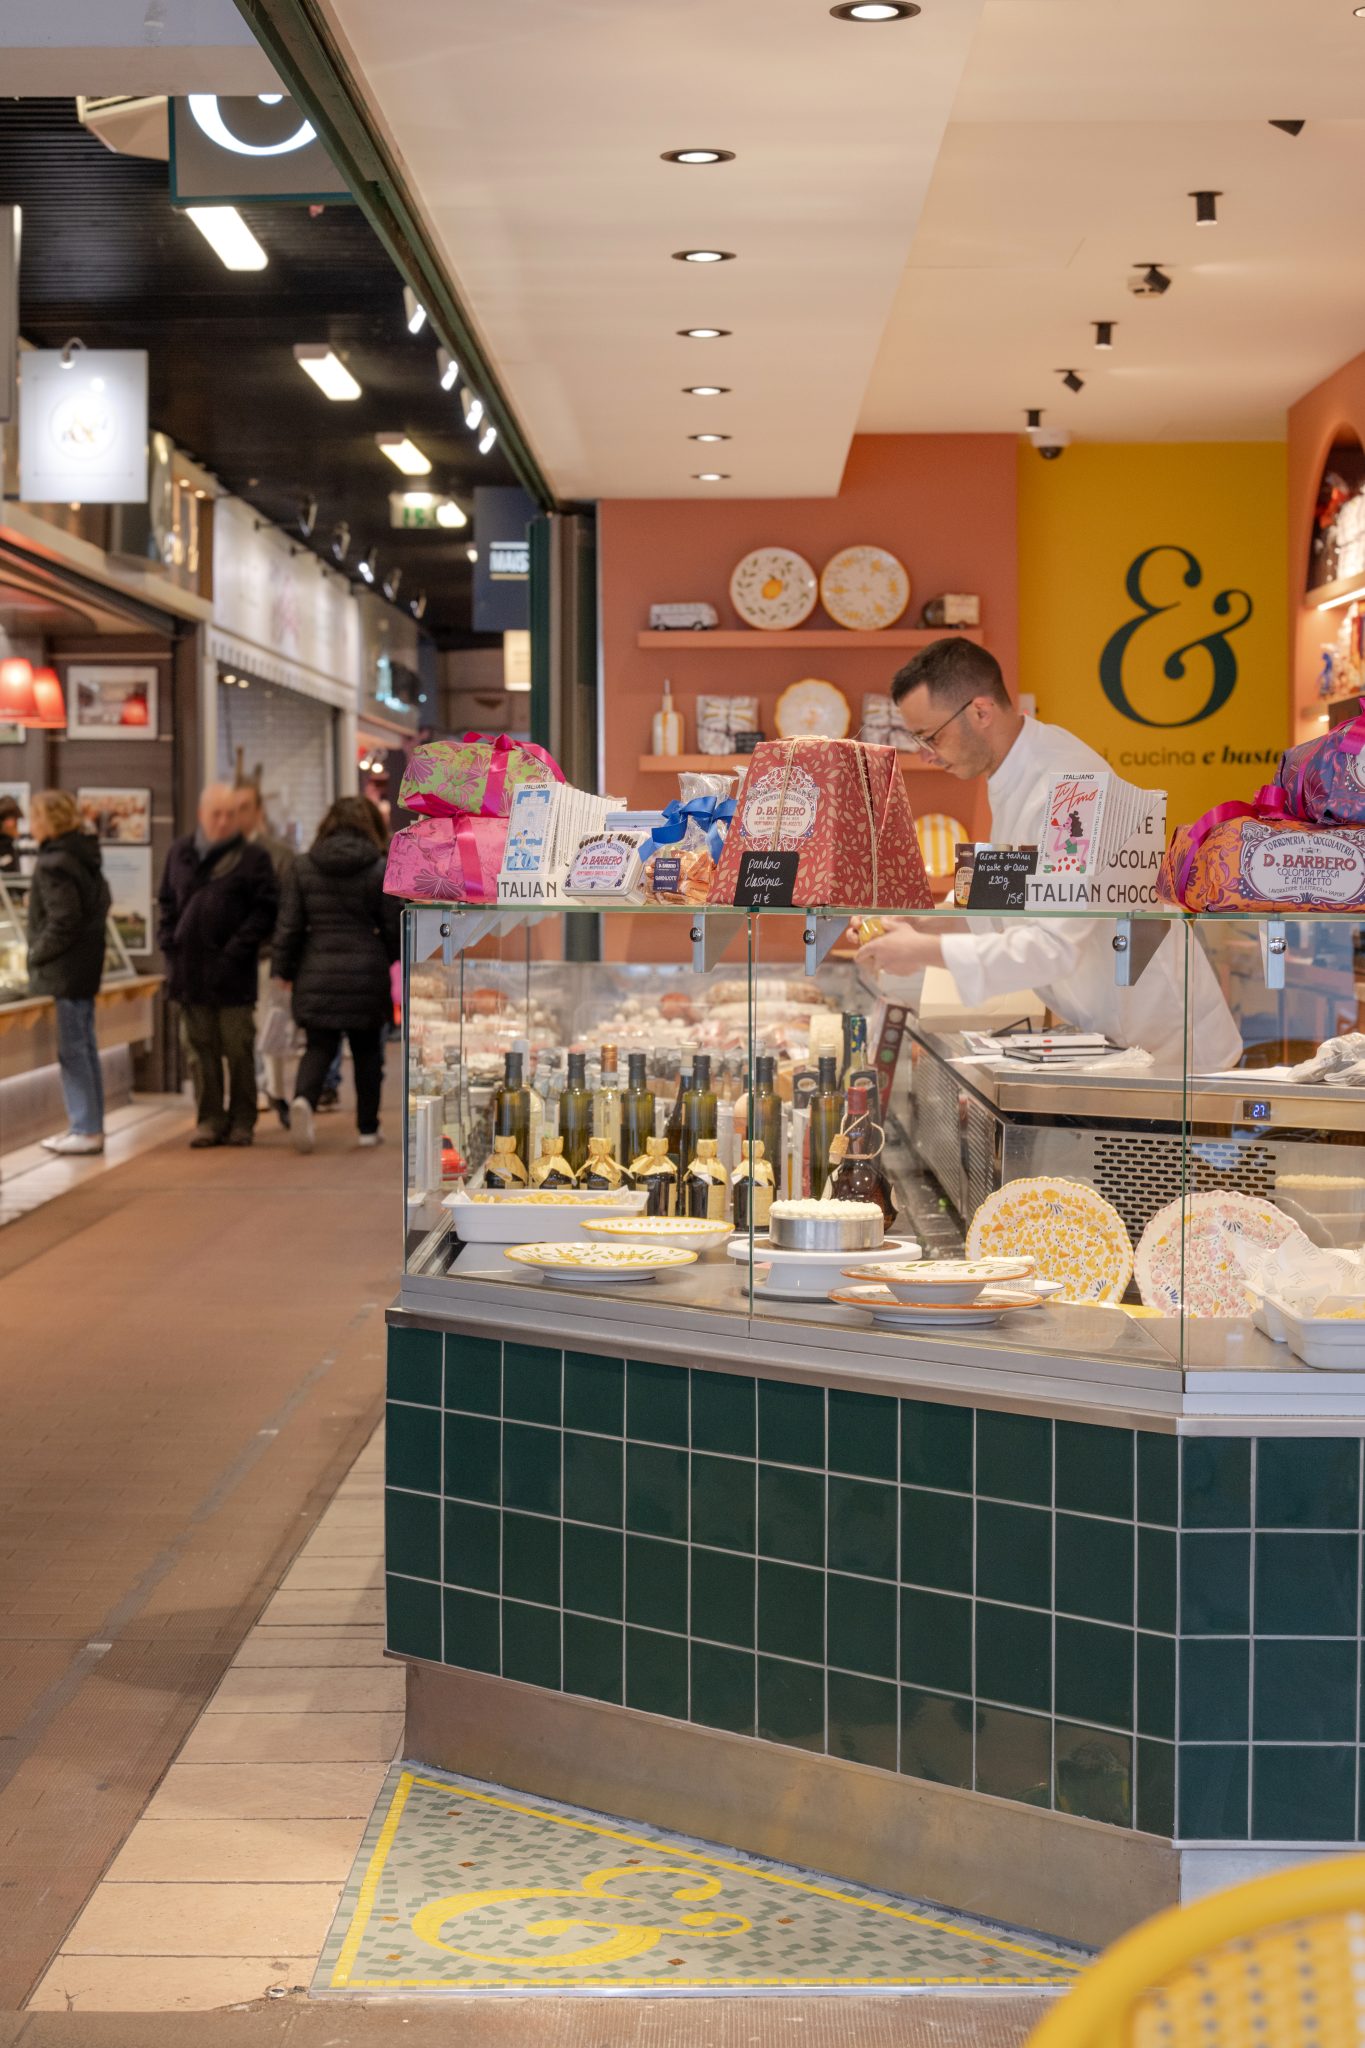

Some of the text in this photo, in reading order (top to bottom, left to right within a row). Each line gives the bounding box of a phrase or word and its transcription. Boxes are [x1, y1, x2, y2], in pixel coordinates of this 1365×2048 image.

[1120, 746, 1196, 767] cucina
[1203, 751, 1215, 765] e
[1052, 782, 1098, 815] Amo
[1053, 781, 1072, 803] Ti
[589, 856, 623, 865] BARBERO
[1263, 853, 1357, 871] D. BARBERO
[1277, 867, 1340, 879] COLOMBA PESCA
[1291, 877, 1332, 886] AMARETTO
[496, 881, 557, 897] ITALIAN
[744, 873, 783, 892] classique
[1006, 893, 1024, 905] 15€
[1025, 883, 1101, 902] ITALIAN
